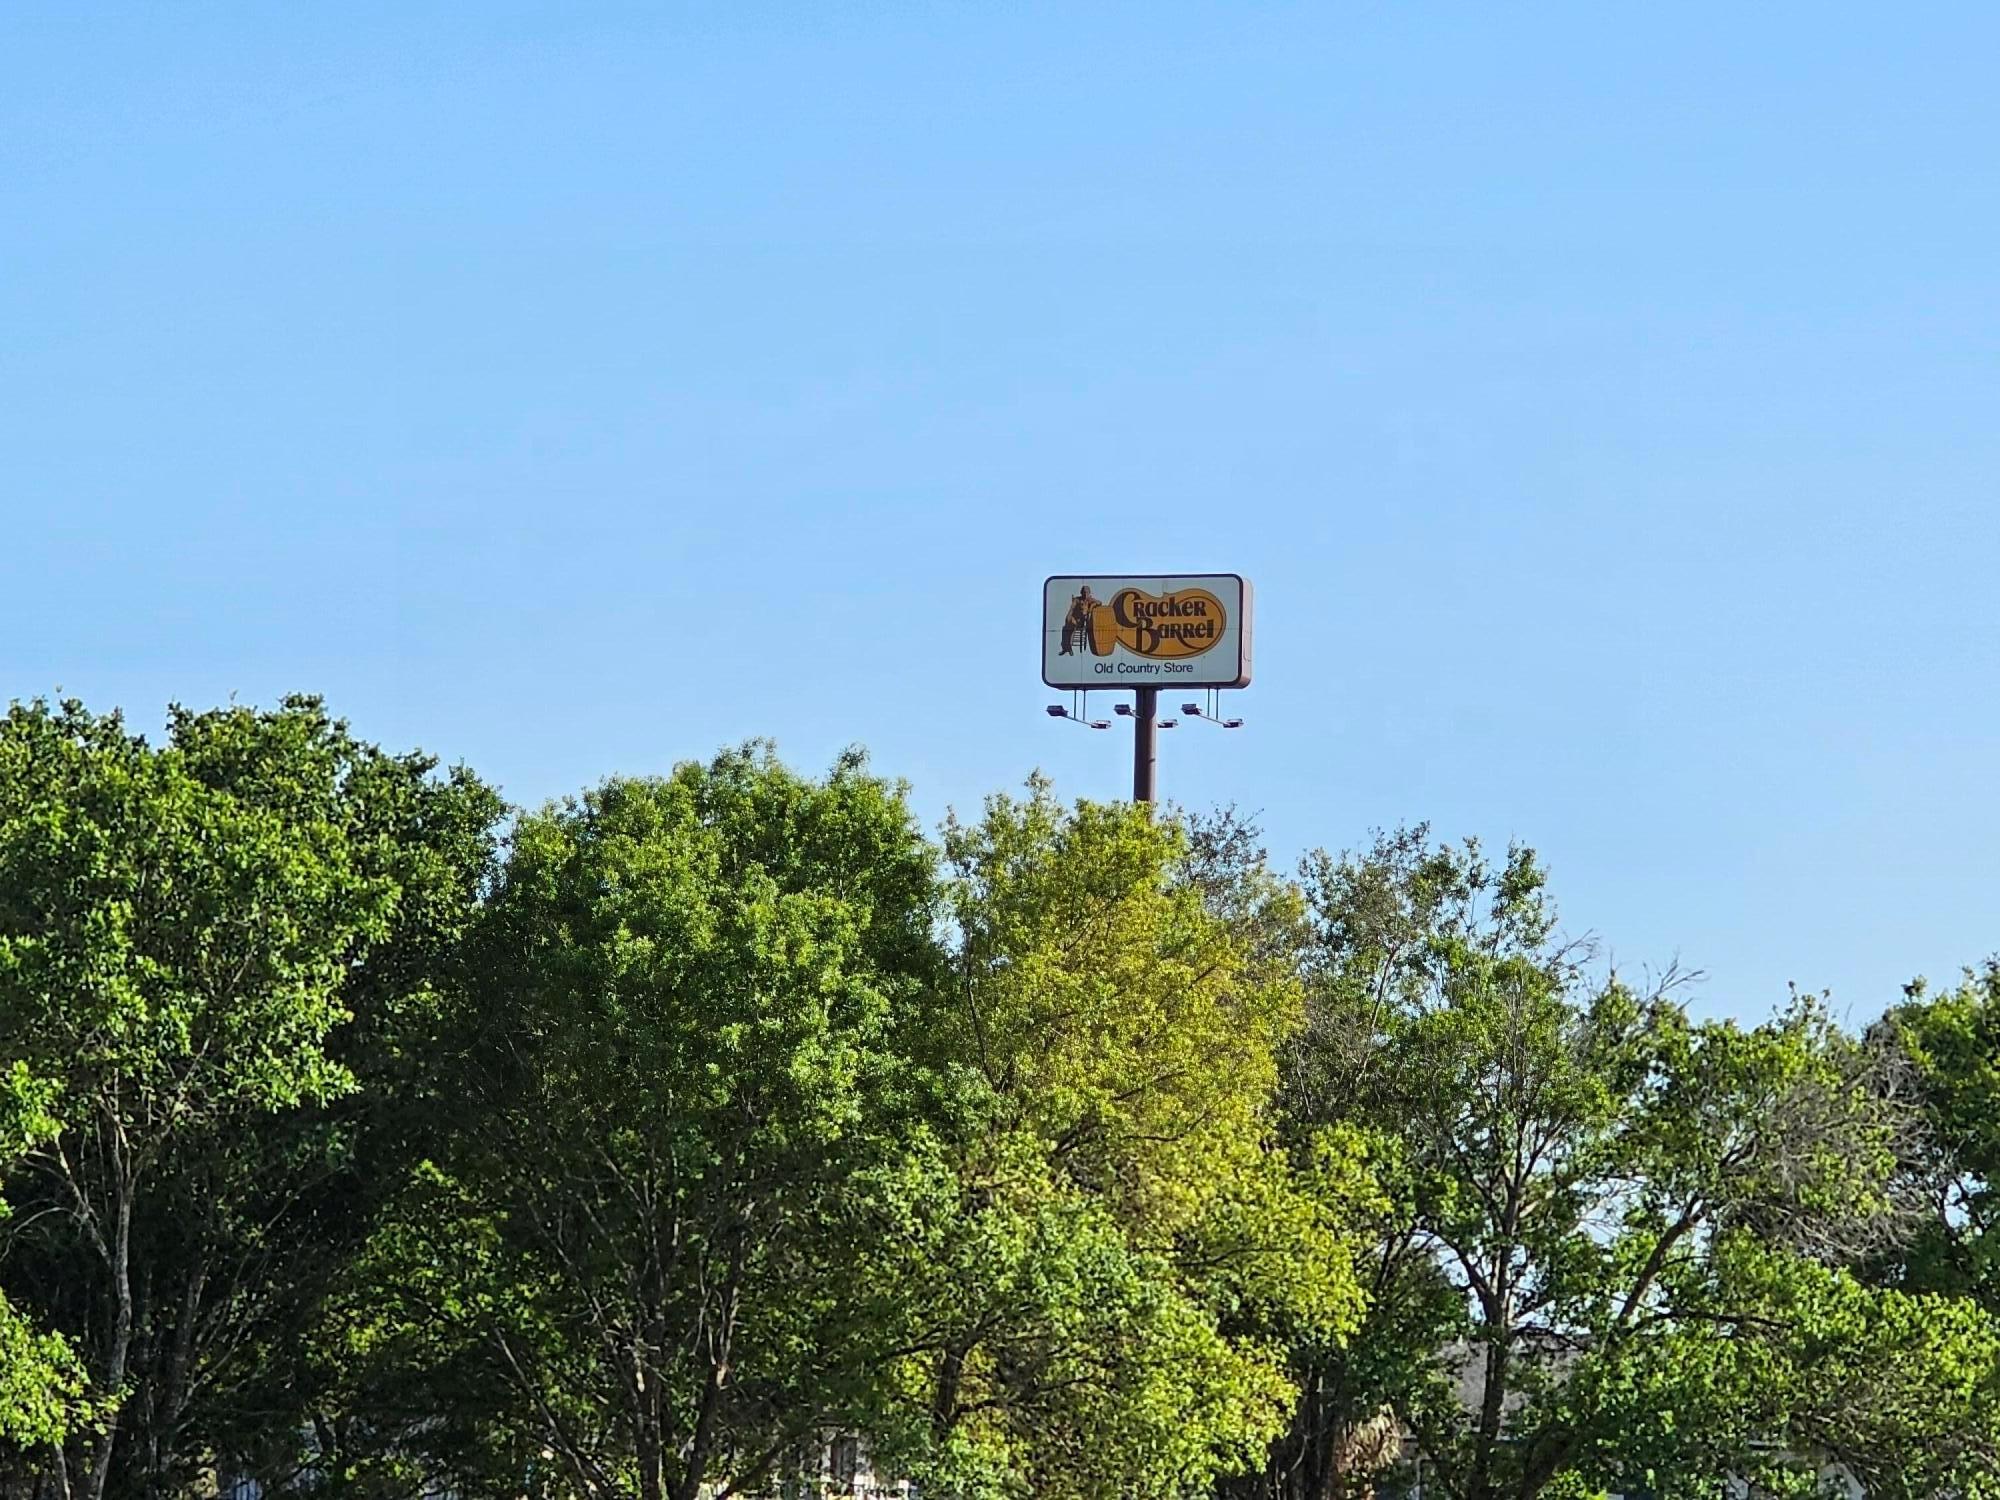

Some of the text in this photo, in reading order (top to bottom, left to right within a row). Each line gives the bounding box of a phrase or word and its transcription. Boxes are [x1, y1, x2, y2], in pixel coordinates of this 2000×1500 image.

[1094, 662, 1193, 675] Old Country Store
